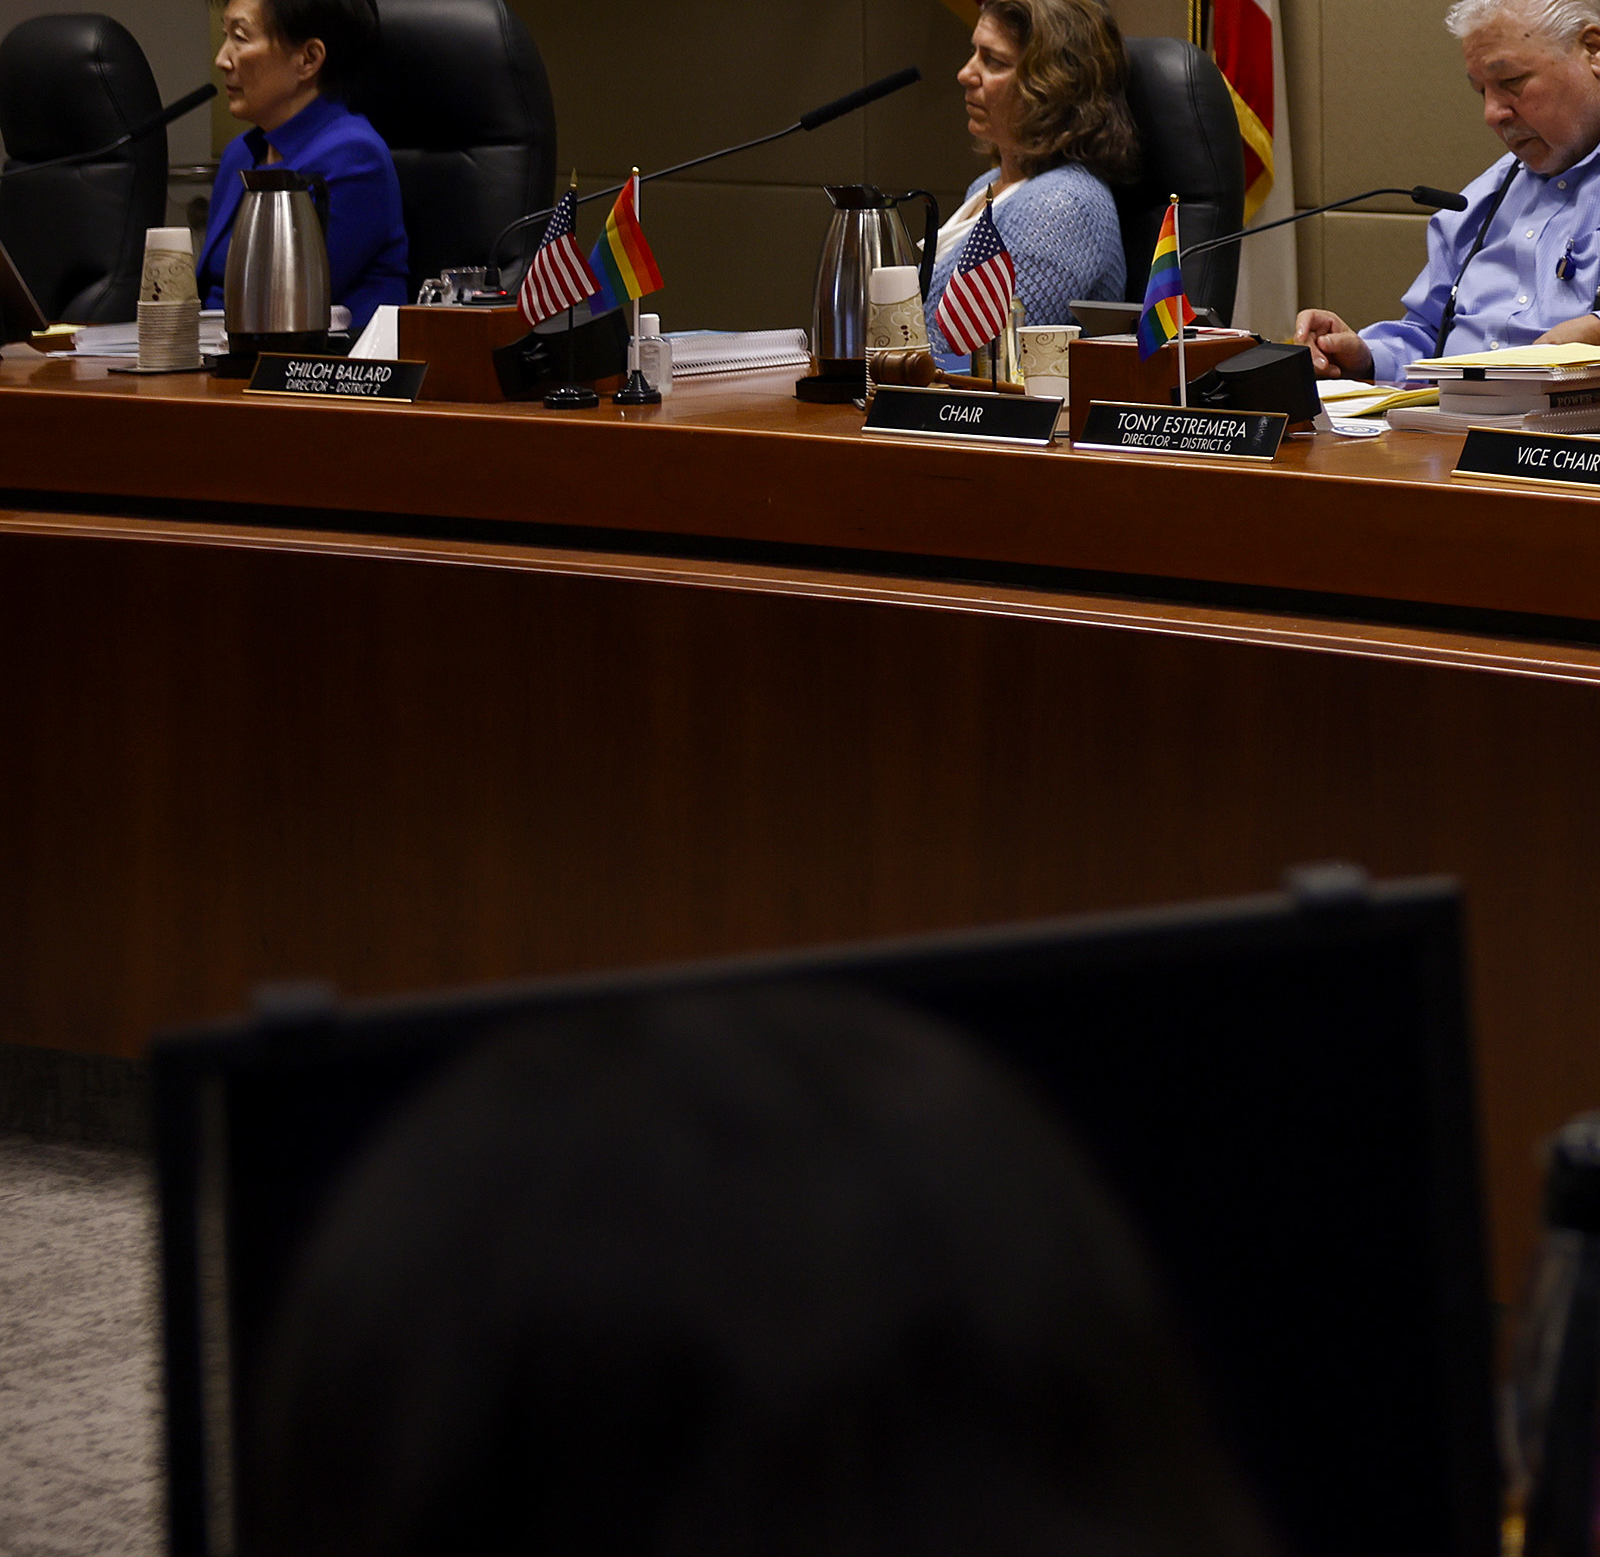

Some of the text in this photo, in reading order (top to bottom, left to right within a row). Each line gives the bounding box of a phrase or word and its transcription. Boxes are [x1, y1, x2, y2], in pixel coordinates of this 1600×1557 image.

[285, 360, 393, 383] SHILOH BALLARD
[285, 378, 330, 392] DIRECTOR
[336, 382, 372, 394] DISTRICT
[372, 384, 381, 395] 2
[939, 404, 984, 424] CHAIR
[1116, 412, 1247, 438] TONY ESTREMERA
[1121, 432, 1170, 448] DIRECTOR
[1179, 436, 1224, 451] DISTRICT
[1223, 439, 1232, 452] 6
[1516, 446, 1551, 467] VICE
